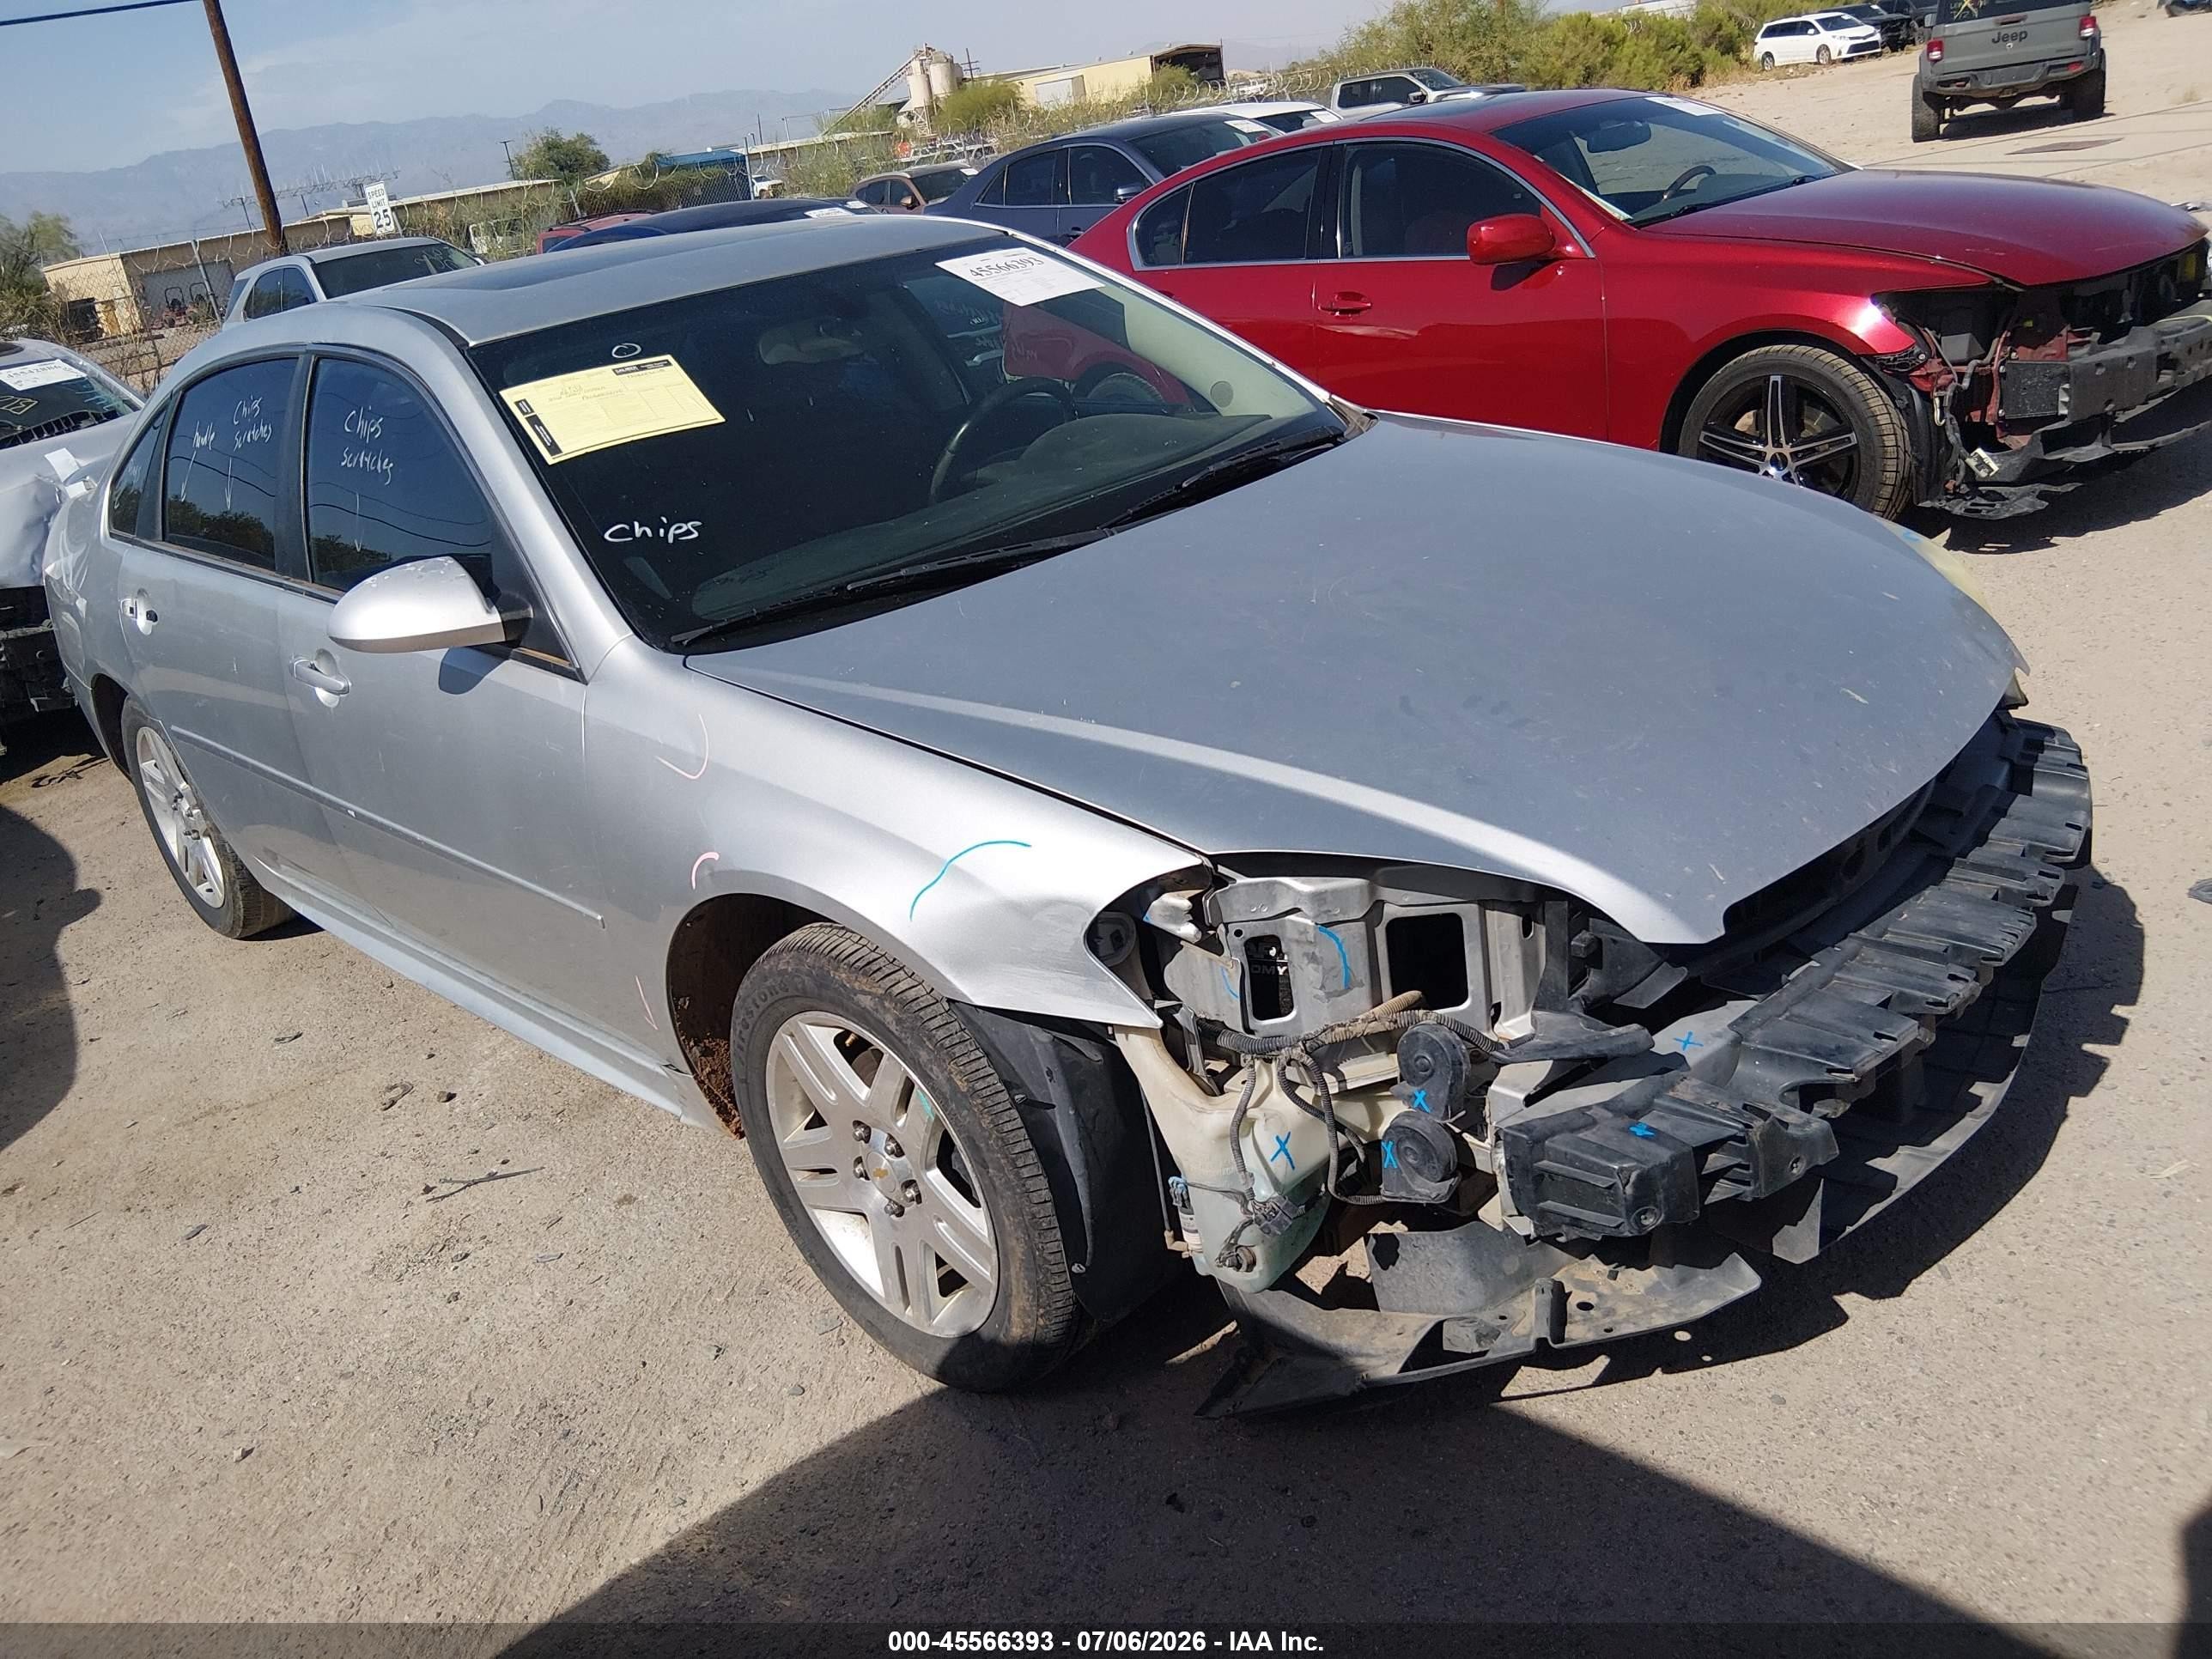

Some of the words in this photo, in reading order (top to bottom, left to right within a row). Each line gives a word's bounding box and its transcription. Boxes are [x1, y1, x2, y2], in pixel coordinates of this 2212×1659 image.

[1992, 30, 2028, 44] Jeep
[368, 188, 385, 199] SPEED
[371, 198, 385, 209] LIMIT
[374, 209, 391, 229] 25
[969, 257, 1045, 277] 45566393
